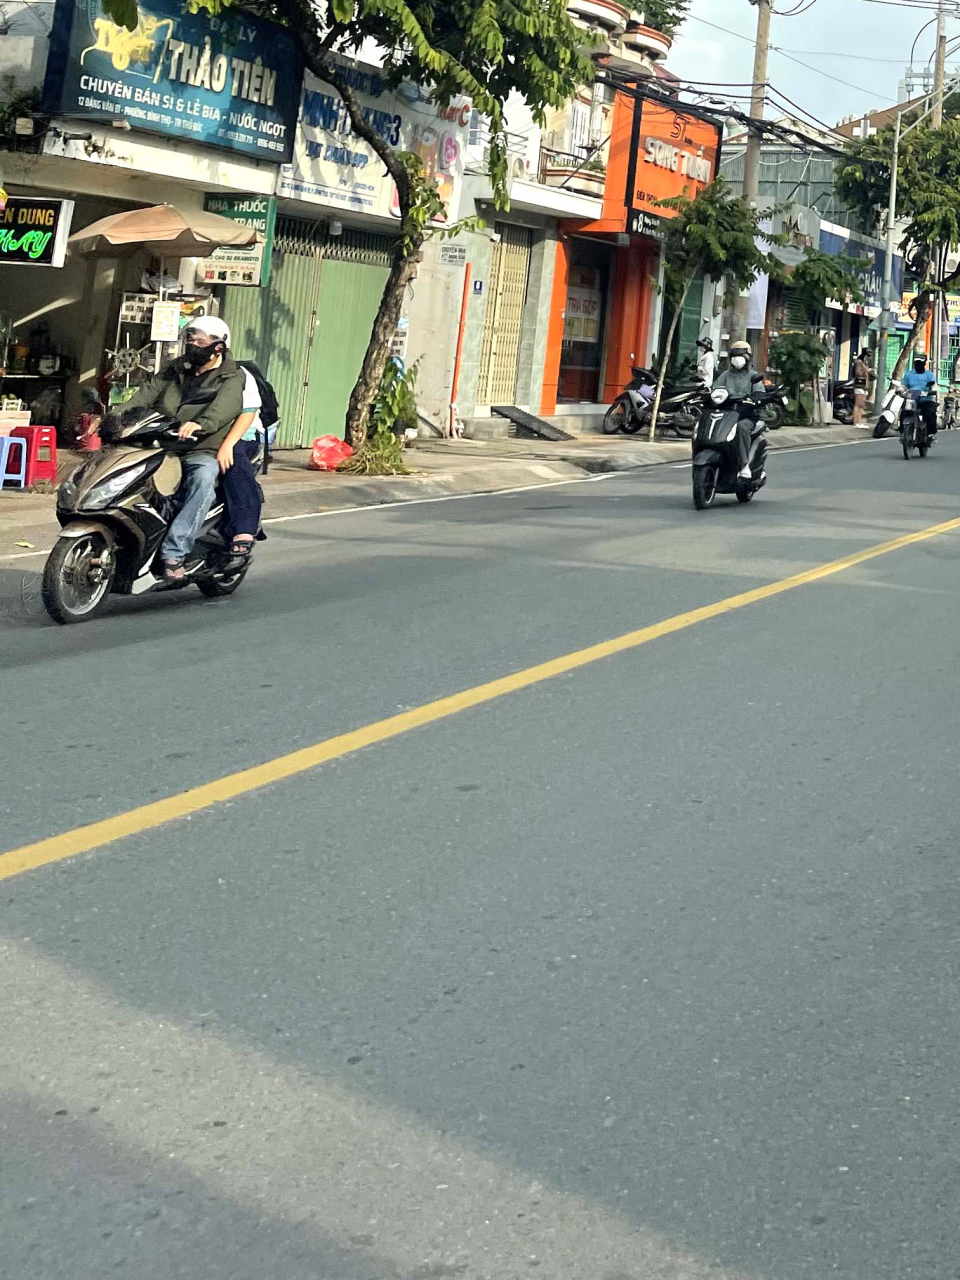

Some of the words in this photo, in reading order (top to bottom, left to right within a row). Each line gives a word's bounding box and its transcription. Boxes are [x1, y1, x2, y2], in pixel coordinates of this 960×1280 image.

[168, 35, 228, 93] THẢO
[231, 54, 277, 107] TIÊN
[80, 75, 132, 99] CHUYÊN
[134, 87, 160, 106] BÁN
[176, 98, 185, 112] &
[187, 98, 200, 116] LẺ
[202, 104, 220, 121] BIA
[229, 111, 258, 131] NƯỚC
[259, 121, 286, 139] NGỌT
[644, 136, 679, 172] SONG
[18, 208, 54, 226] DUNG
[233, 195, 267, 213] THUỐC
